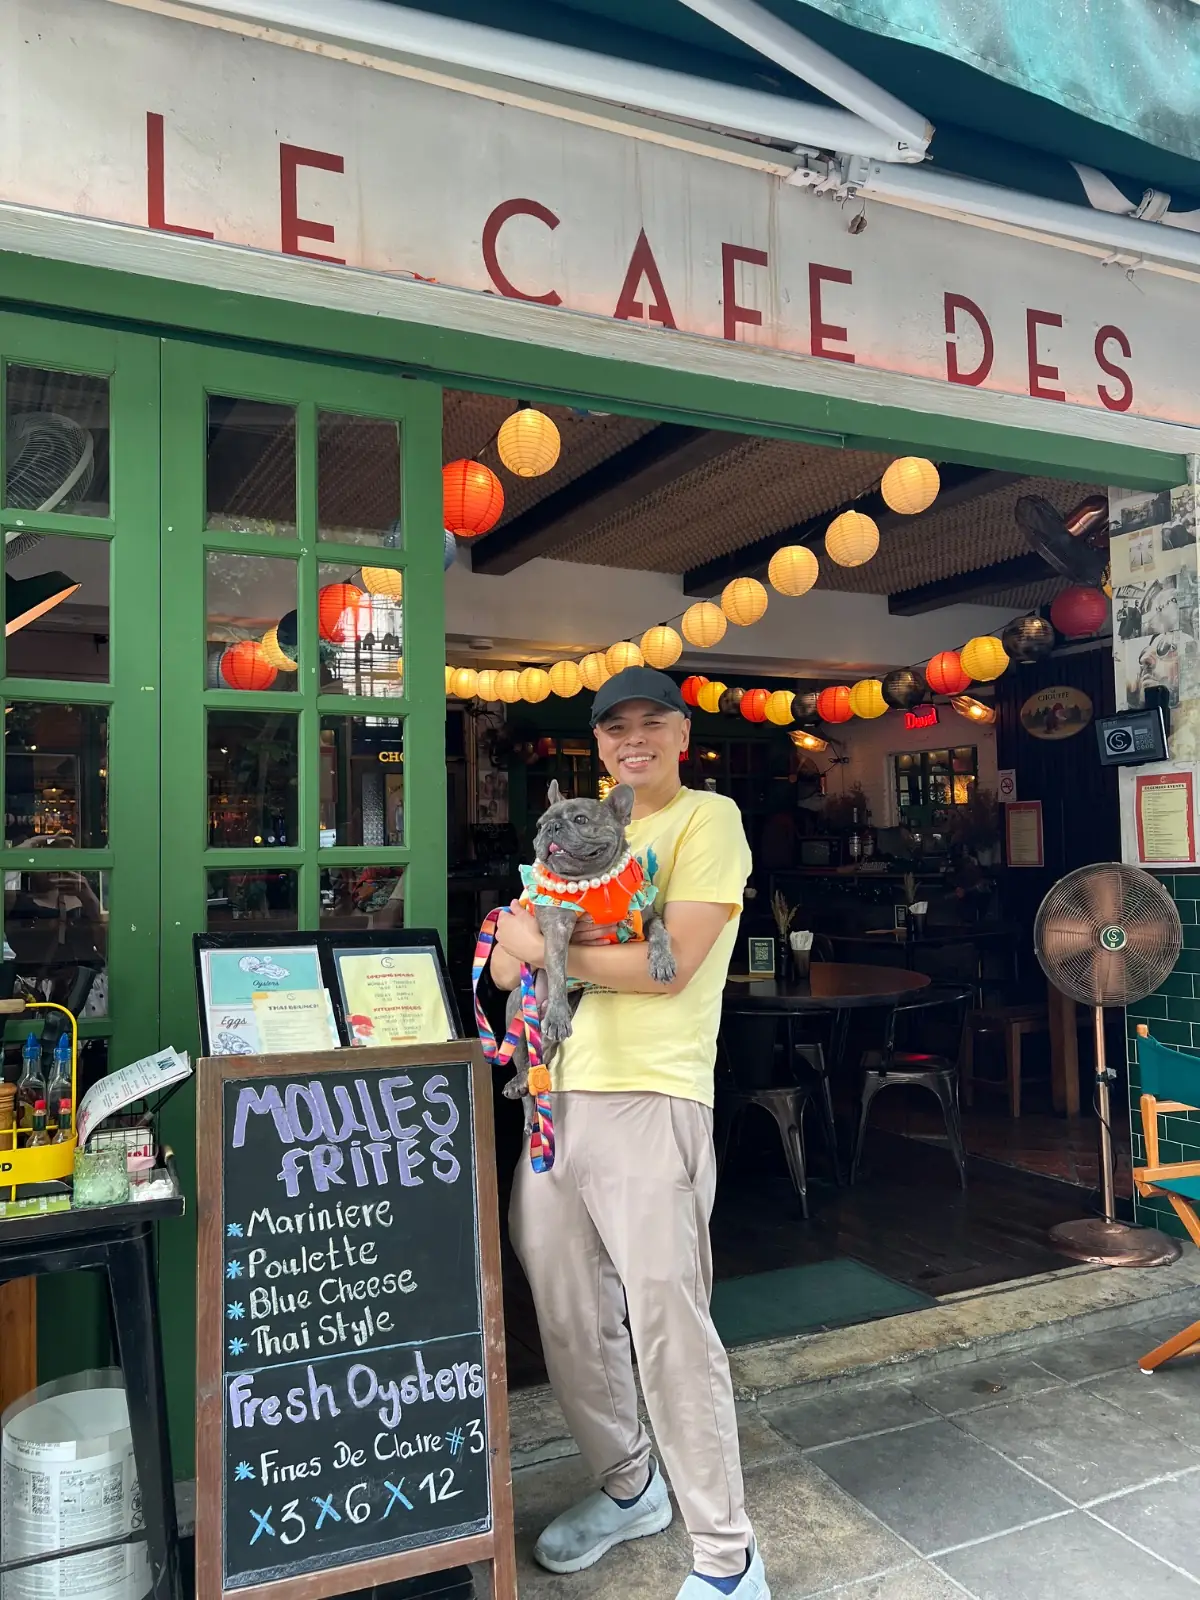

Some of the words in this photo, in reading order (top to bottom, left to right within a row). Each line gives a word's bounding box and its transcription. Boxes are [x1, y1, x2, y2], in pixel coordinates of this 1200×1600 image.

[147, 112, 346, 264] LE
[483, 198, 855, 364] CAFE
[944, 292, 1133, 411] DES
[252, 980, 280, 988] Oysters
[221, 1015, 247, 1029] Eggs
[232, 1074, 460, 1148] MOULES
[246, 1200, 394, 1237] Mariniere
[248, 1234, 378, 1279] Poulette
[249, 1286, 312, 1320] Blue
[318, 1268, 418, 1306] Cheese
[250, 1321, 311, 1357] Thai
[318, 1305, 395, 1347] Style
[229, 1364, 342, 1429] Fresh
[346, 1350, 484, 1429] Oysters
[260, 1449, 322, 1486] Fines
[332, 1440, 367, 1469] De
[374, 1432, 444, 1461] Claire
